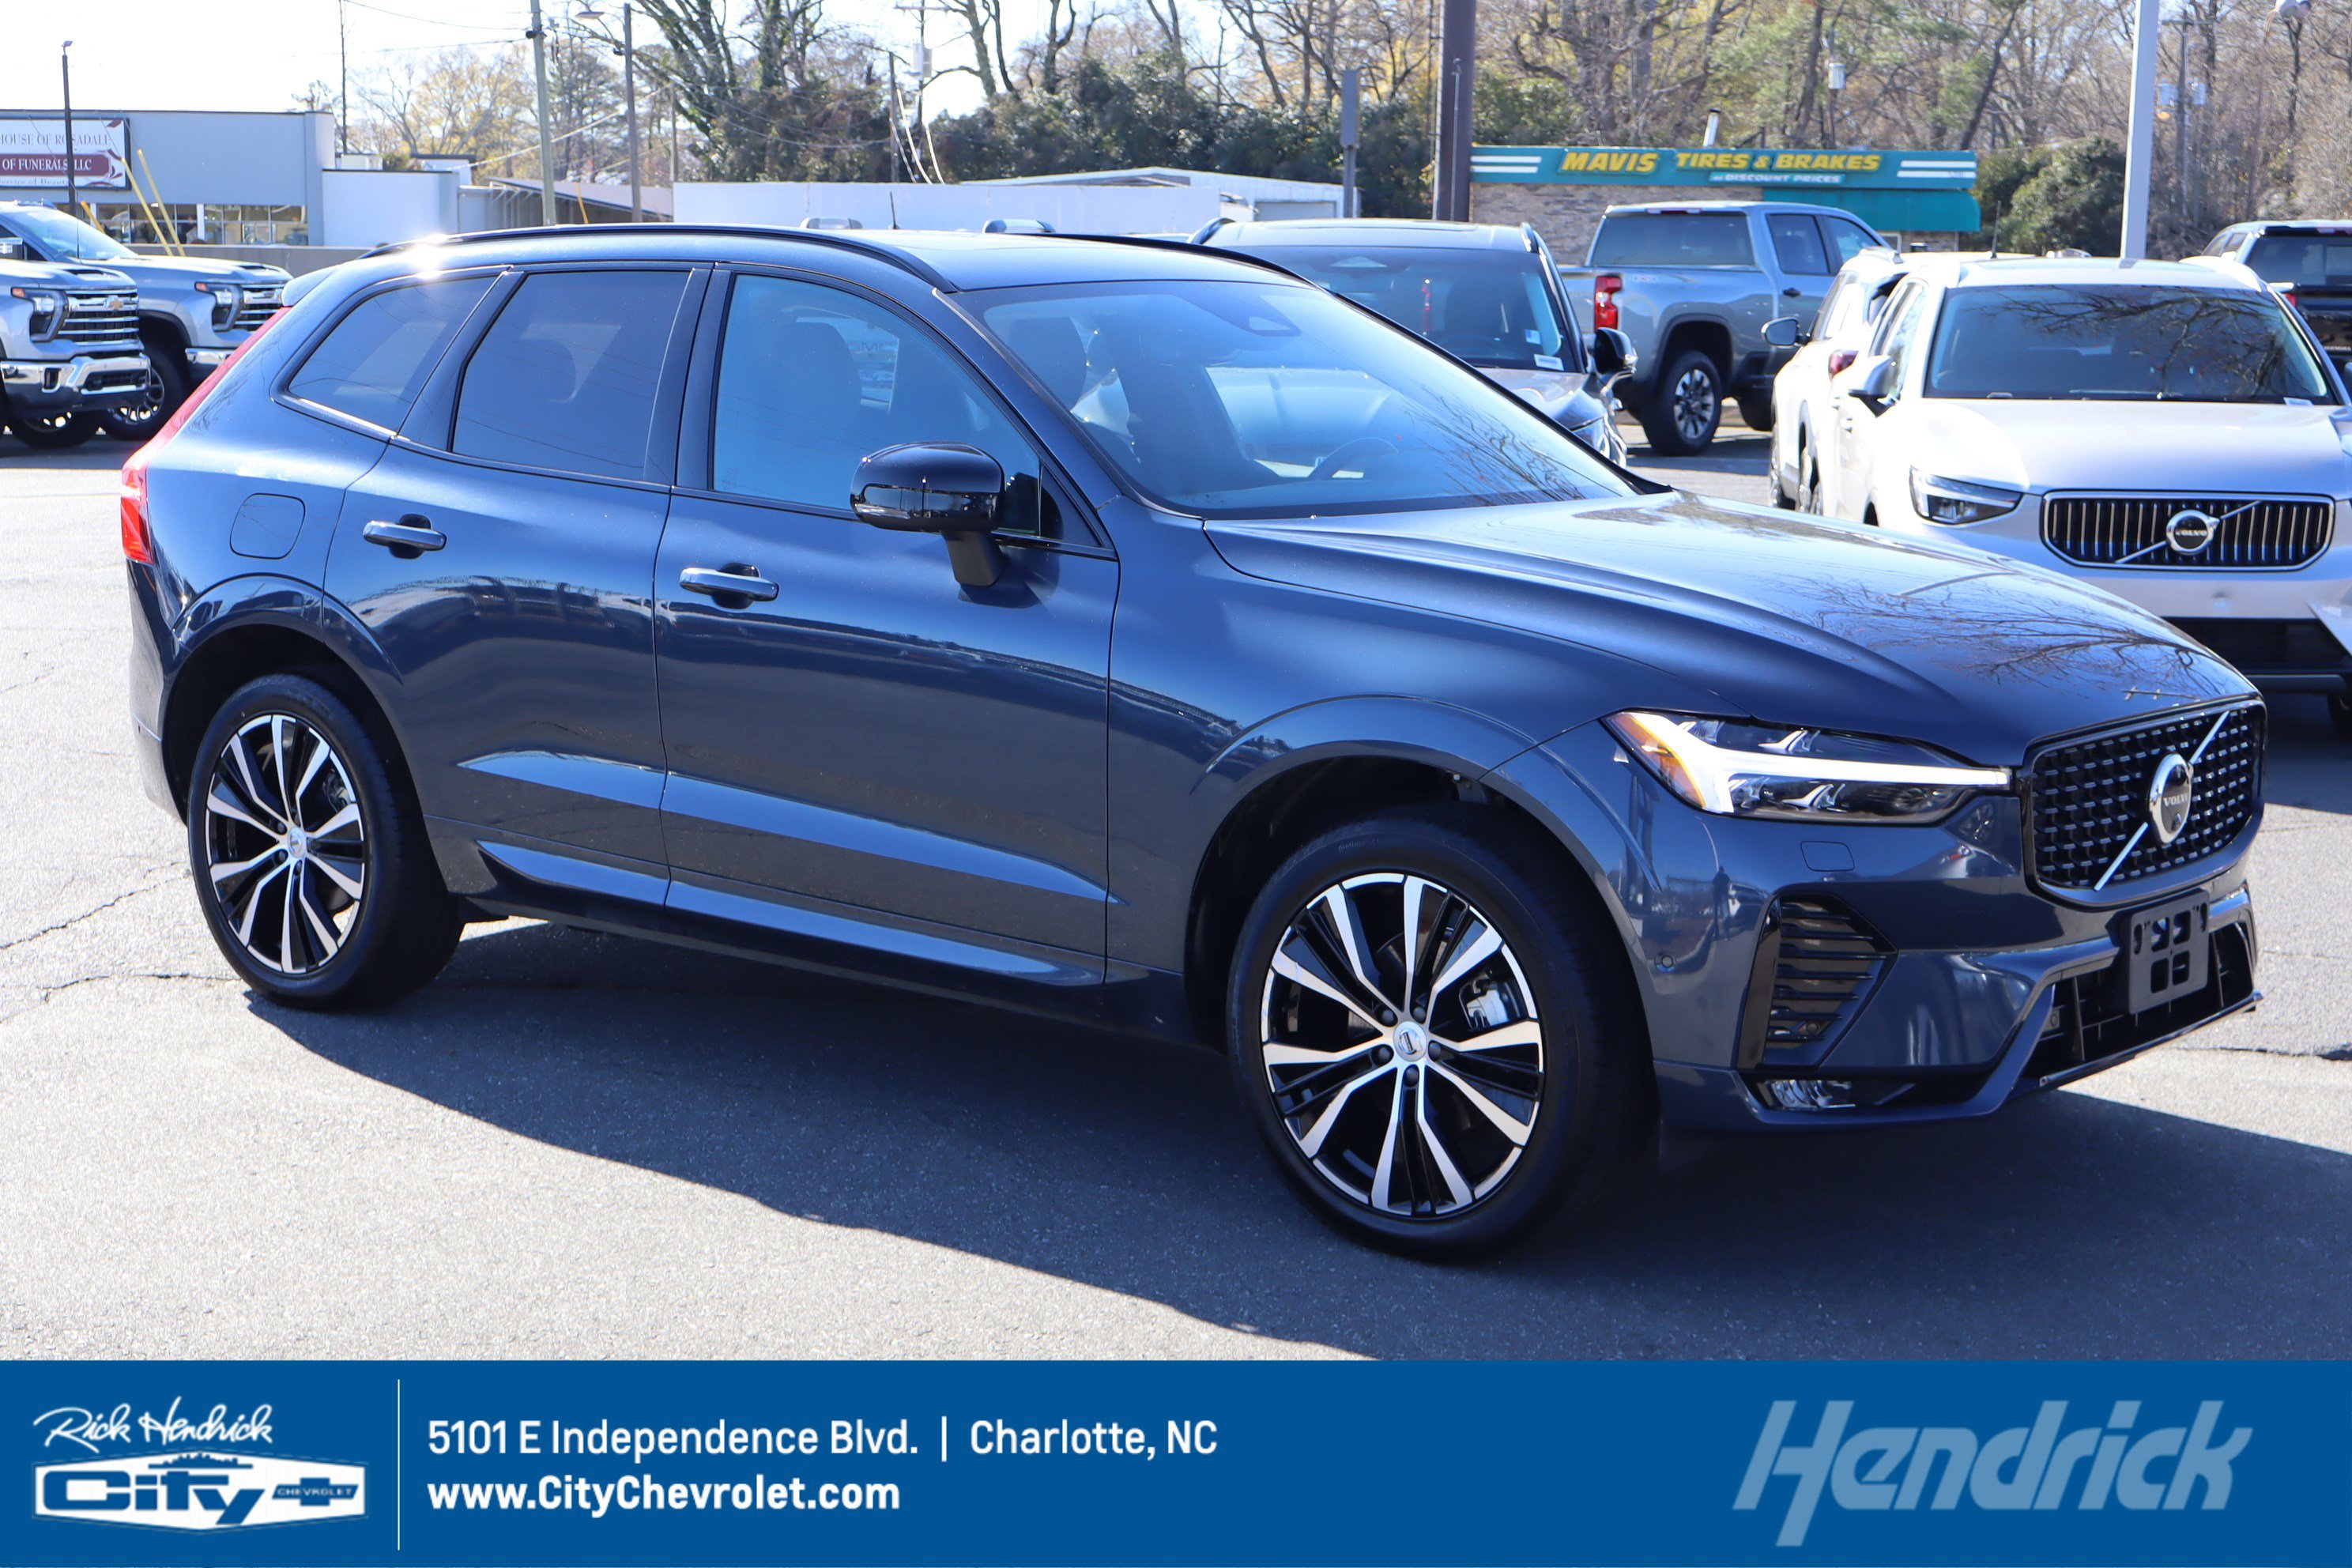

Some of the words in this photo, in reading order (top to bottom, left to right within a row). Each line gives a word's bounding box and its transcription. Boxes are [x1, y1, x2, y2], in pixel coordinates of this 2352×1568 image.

[37, 134, 52, 145] OF
[2, 158, 17, 171] OF
[18, 158, 69, 171] FUNERALS
[74, 158, 92, 170] LLC
[1561, 152, 1659, 172] MAVIS
[1675, 153, 1752, 169] TIRES
[1753, 155, 1770, 169] &
[1775, 153, 1882, 171] BRAKES
[1724, 173, 1790, 183] DISCOUNT
[1792, 175, 1841, 184] PRICES
